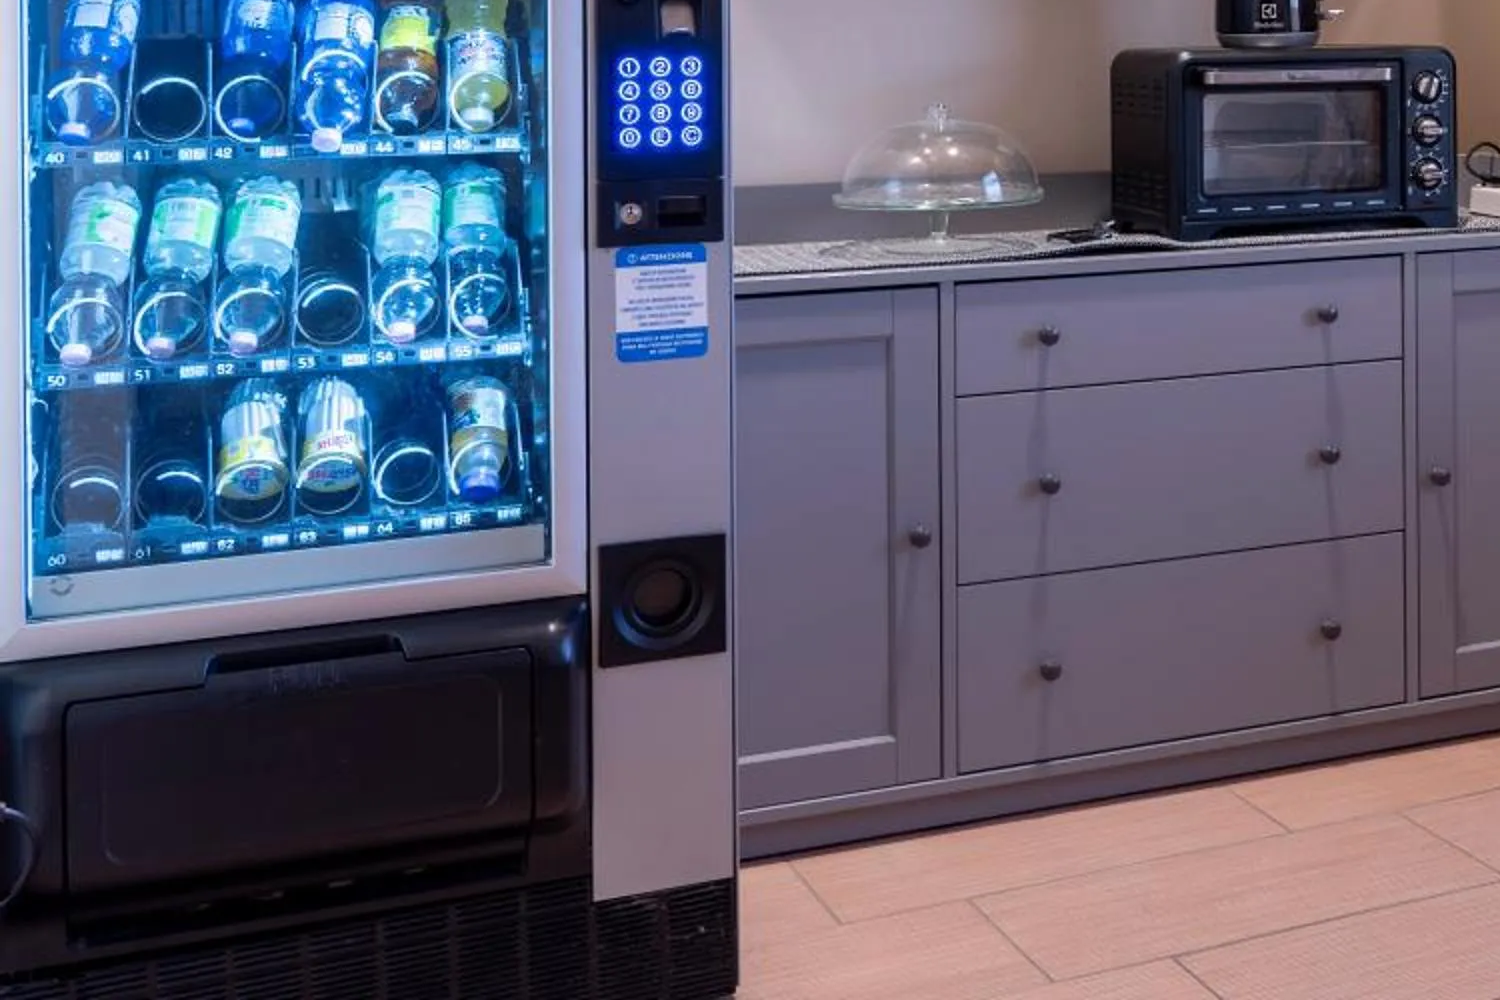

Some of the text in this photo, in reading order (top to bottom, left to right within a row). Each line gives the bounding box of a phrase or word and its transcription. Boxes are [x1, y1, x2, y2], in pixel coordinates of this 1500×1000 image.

[132, 149, 149, 161] 41
[134, 369, 150, 381] 51
[216, 364, 234, 375] 52
[48, 375, 65, 386] 50
[48, 554, 66, 567] 60
